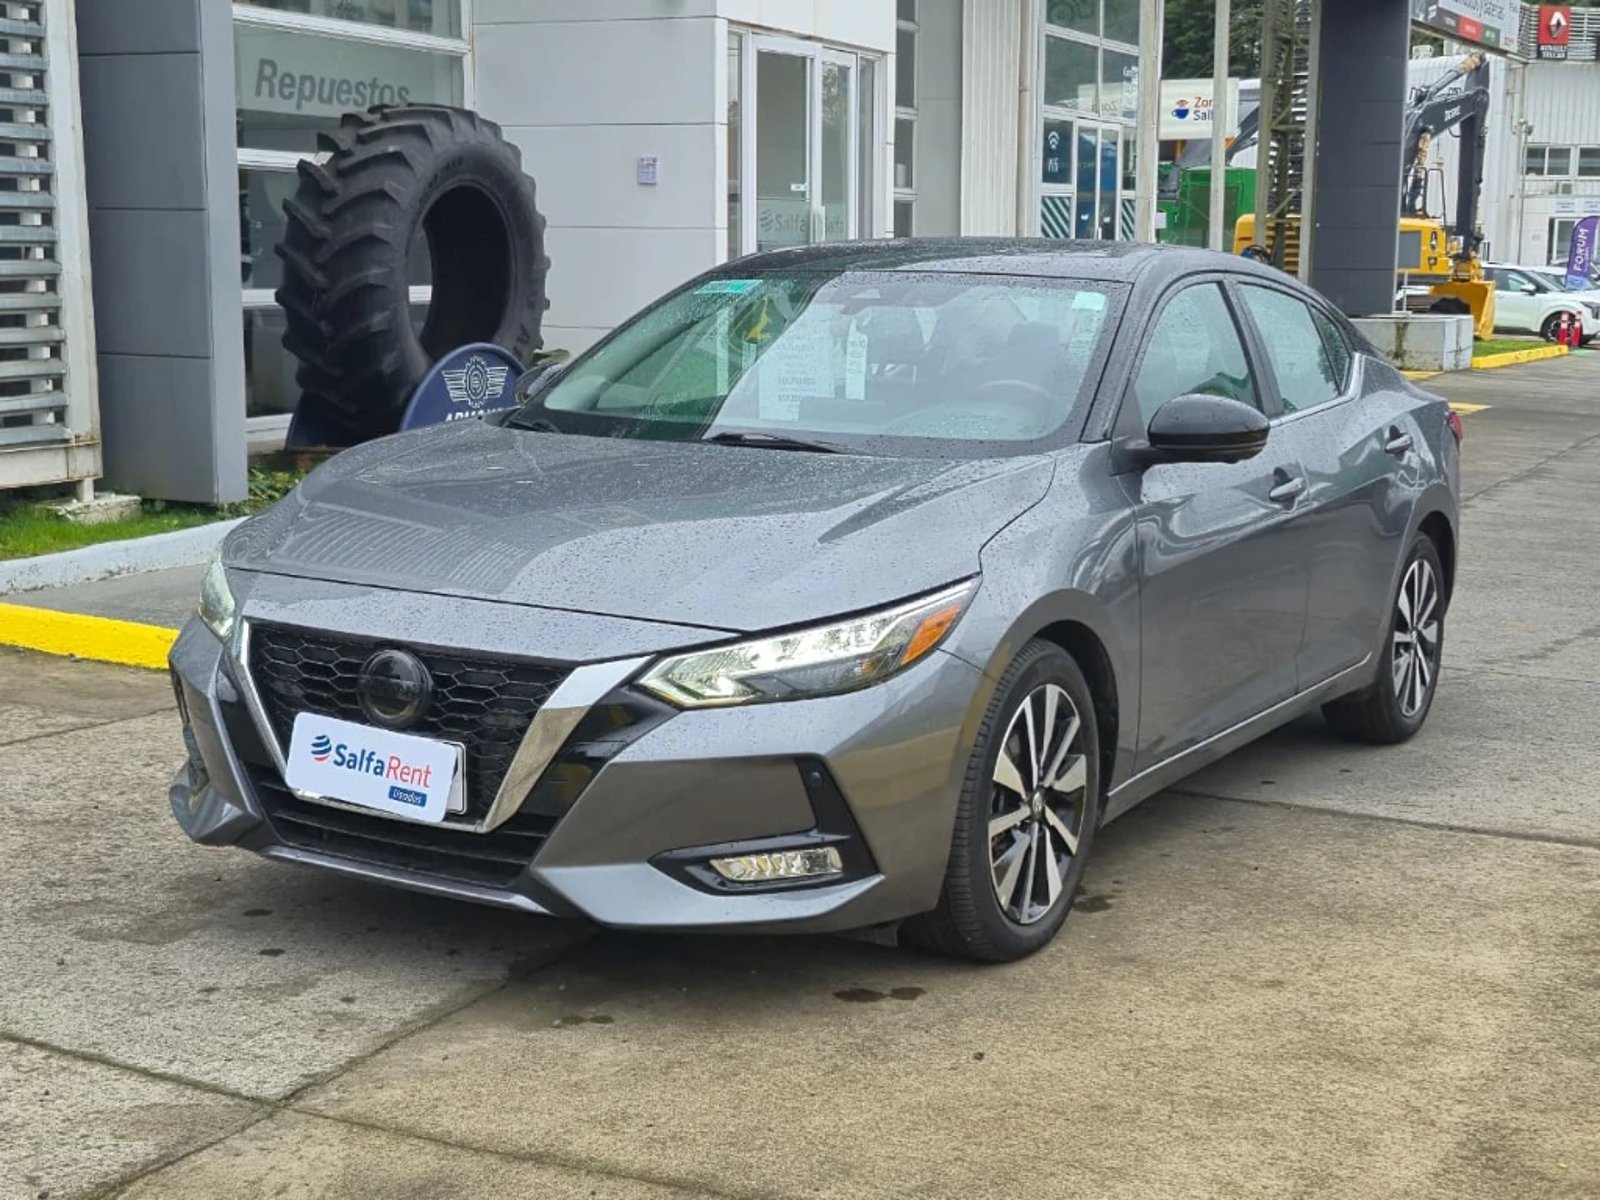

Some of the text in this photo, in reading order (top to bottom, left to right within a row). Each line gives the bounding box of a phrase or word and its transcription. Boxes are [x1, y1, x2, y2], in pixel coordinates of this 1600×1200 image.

[255, 58, 410, 110] Repuestos
[1573, 228, 1590, 272] FORUM
[334, 743, 432, 788] SalfaRent
